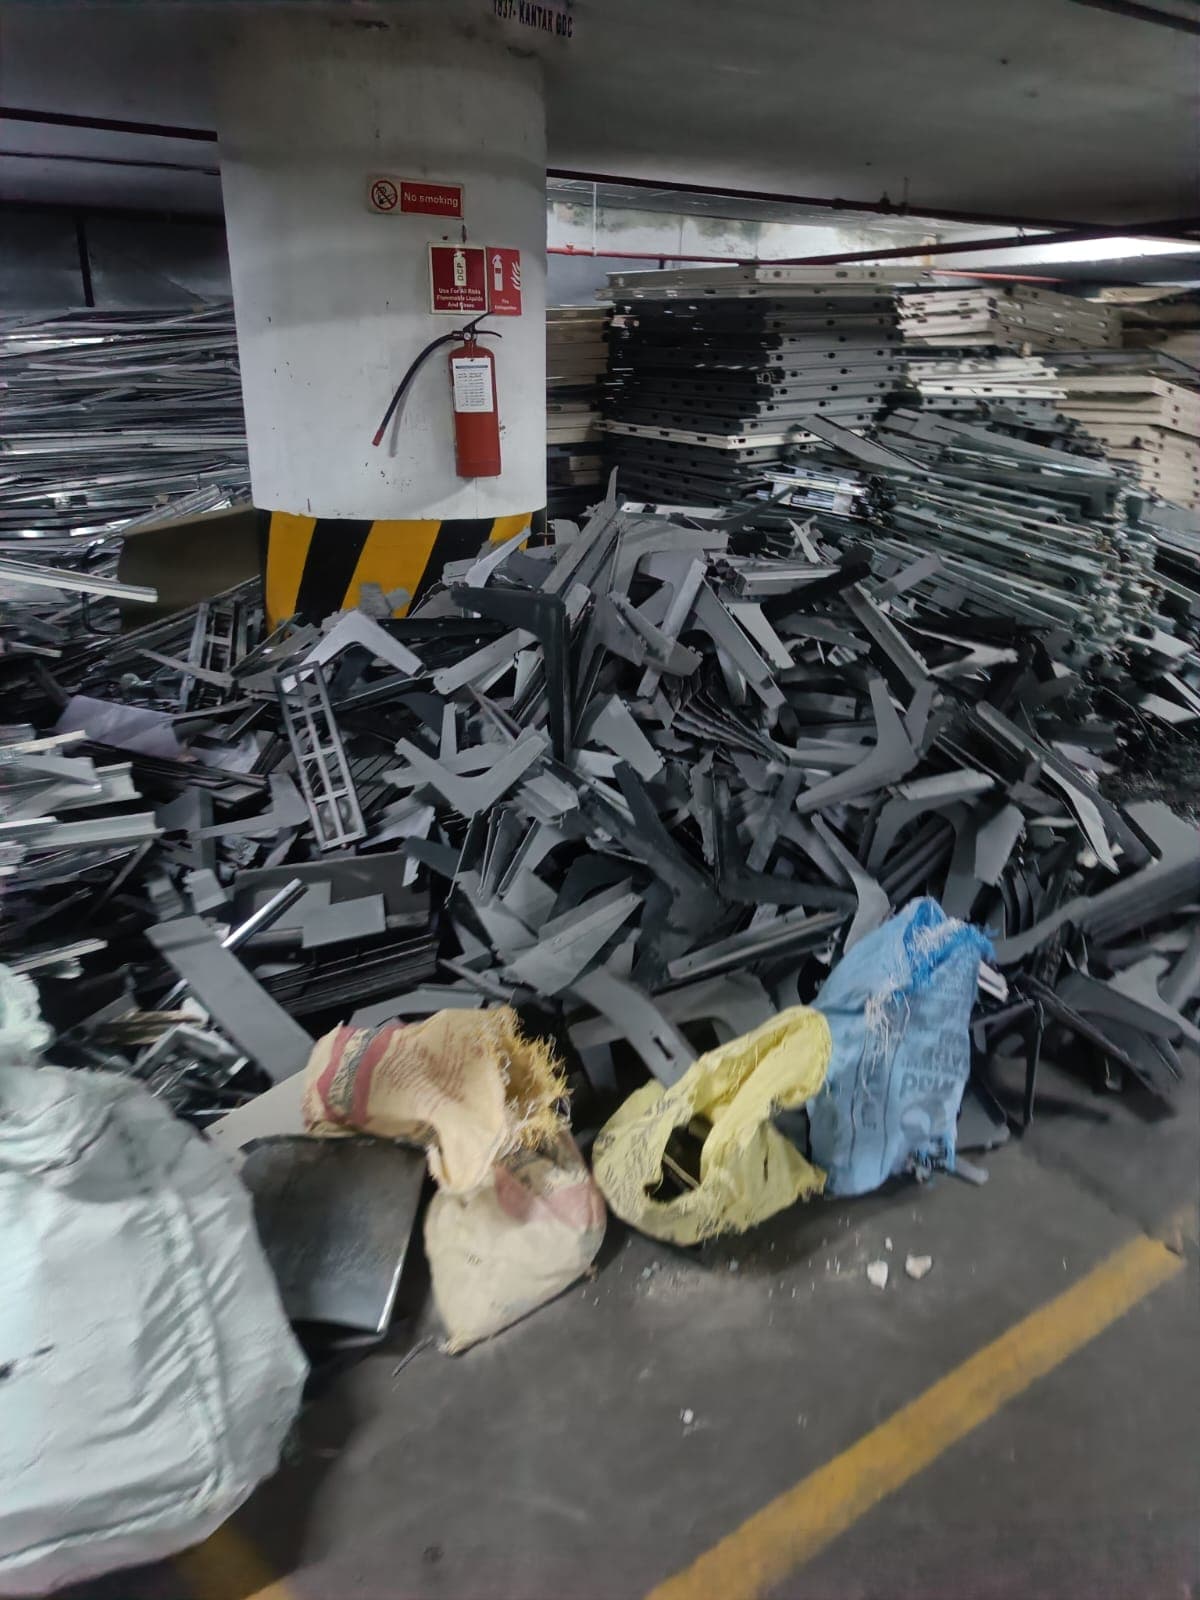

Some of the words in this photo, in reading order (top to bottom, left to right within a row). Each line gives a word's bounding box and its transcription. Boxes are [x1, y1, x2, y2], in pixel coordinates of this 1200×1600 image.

[519, 1, 553, 32] KANTAR
[404, 191, 417, 202] No
[419, 195, 459, 208] smoking
